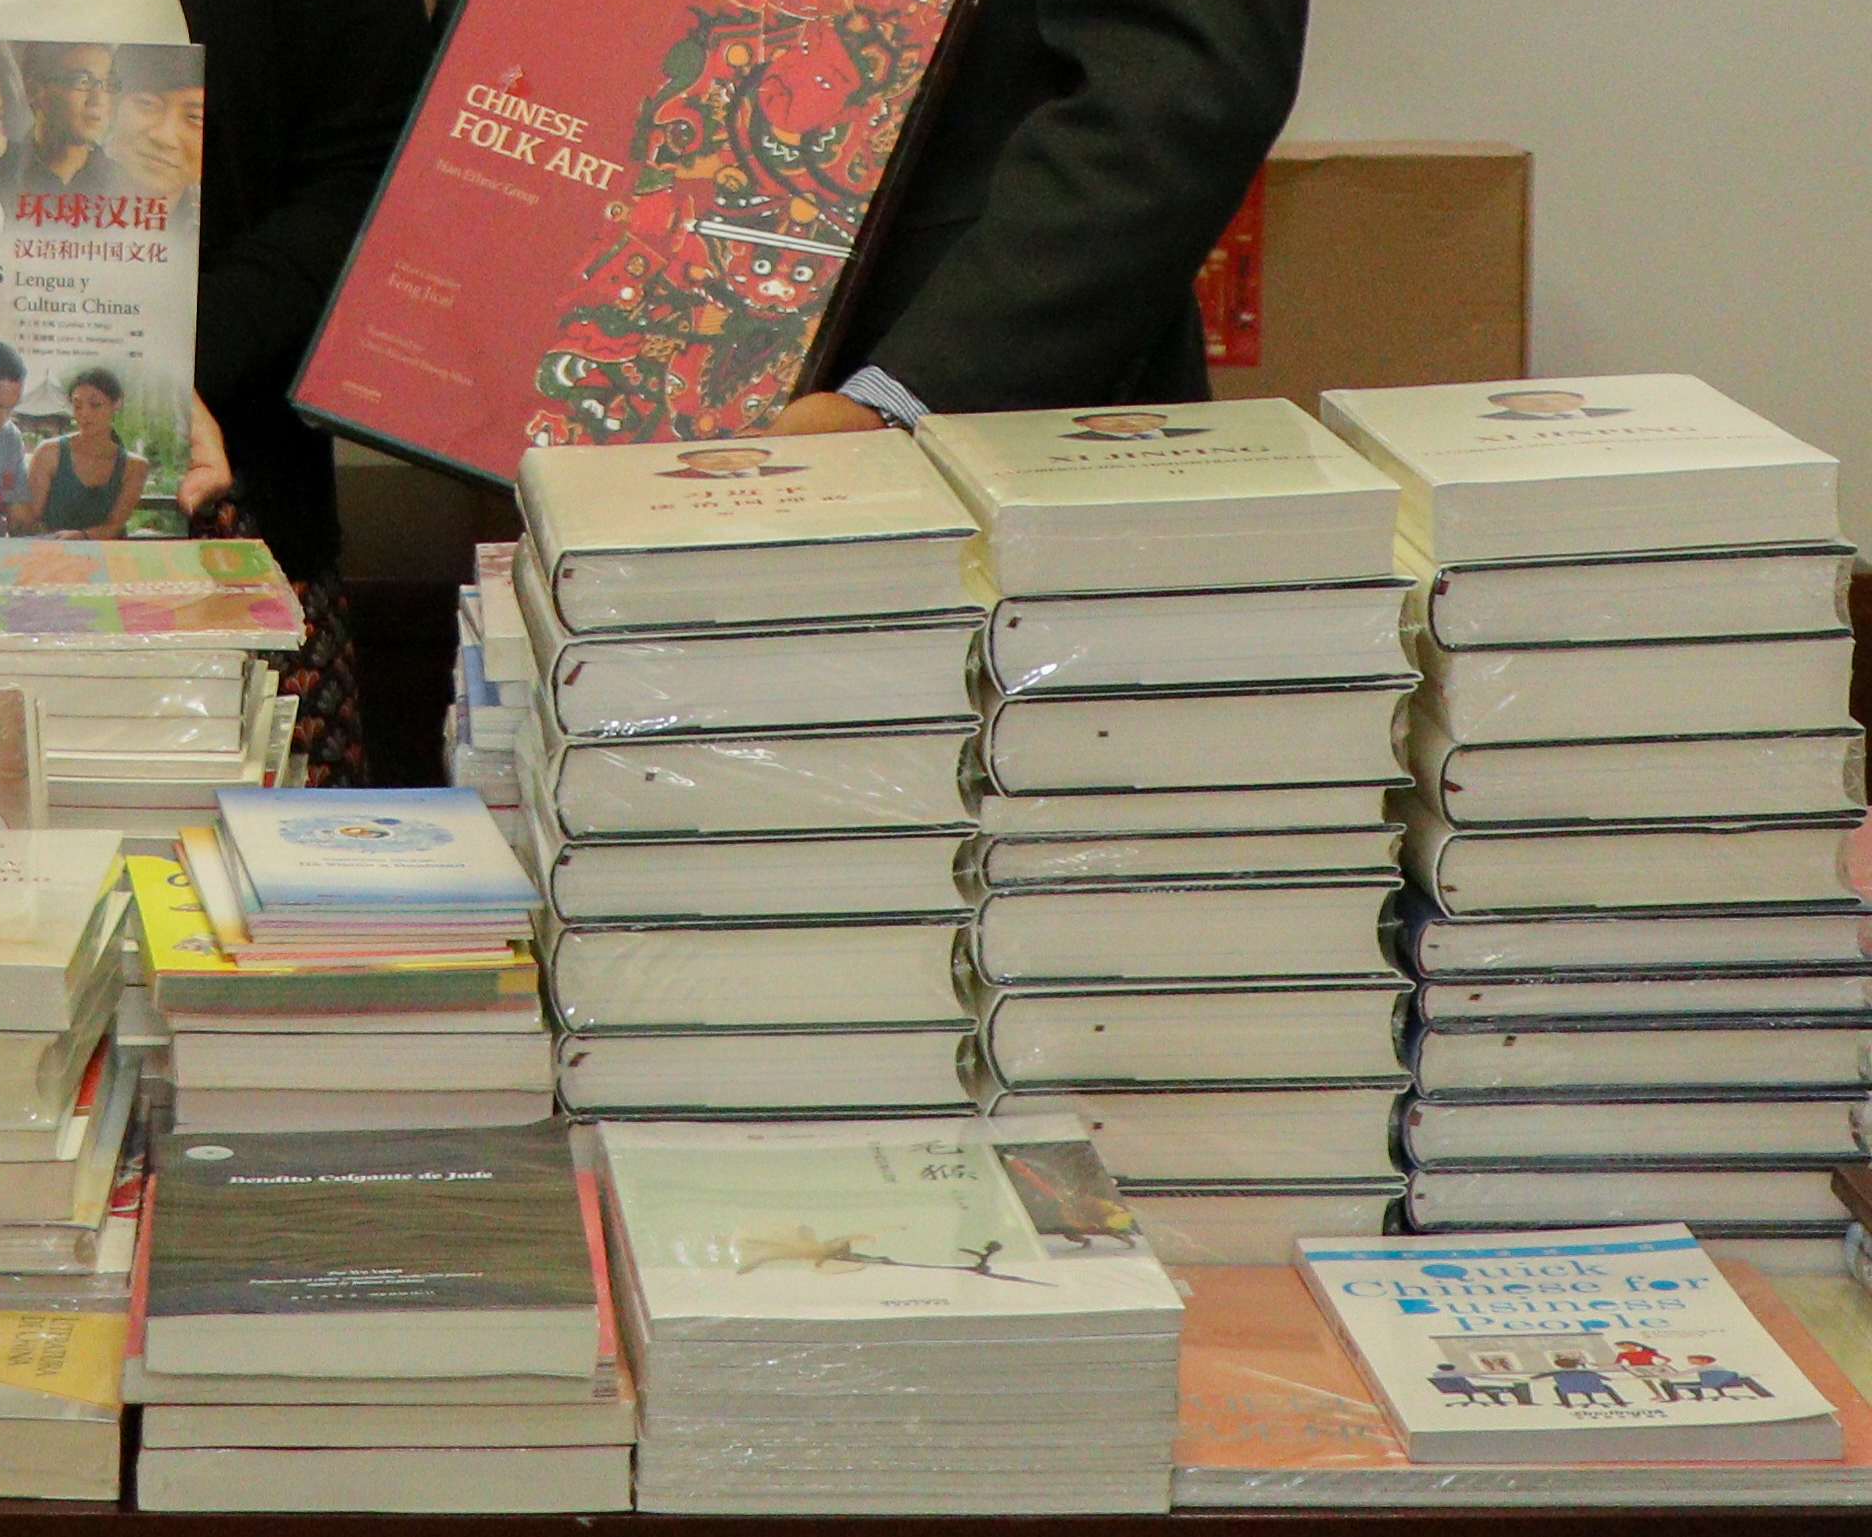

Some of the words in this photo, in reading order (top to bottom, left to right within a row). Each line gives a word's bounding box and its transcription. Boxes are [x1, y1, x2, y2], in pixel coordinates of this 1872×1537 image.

[467, 84, 588, 143] CHINESE
[450, 110, 544, 165] FOLK
[544, 147, 625, 191] ART
[16, 192, 169, 231] 环球汉语
[15, 239, 169, 263] 汉语和中国文化
[15, 270, 76, 293] Lengua
[78, 275, 90, 292] y
[14, 296, 77, 313] Cultura
[82, 297, 141, 315] Chinas
[1048, 454, 1090, 463] XI
[1105, 445, 1271, 461] JINPING
[228, 1173, 312, 1185] Bendito
[318, 1170, 413, 1184] Colgante
[416, 1169, 442, 1181] de
[445, 1168, 494, 1182] Jade
[1420, 1259, 1610, 1282] Quick
[1342, 1277, 1602, 1298] Chinese
[1624, 1274, 1710, 1293] for
[1394, 1295, 1687, 1316] Business
[1454, 1312, 1672, 1333] People
